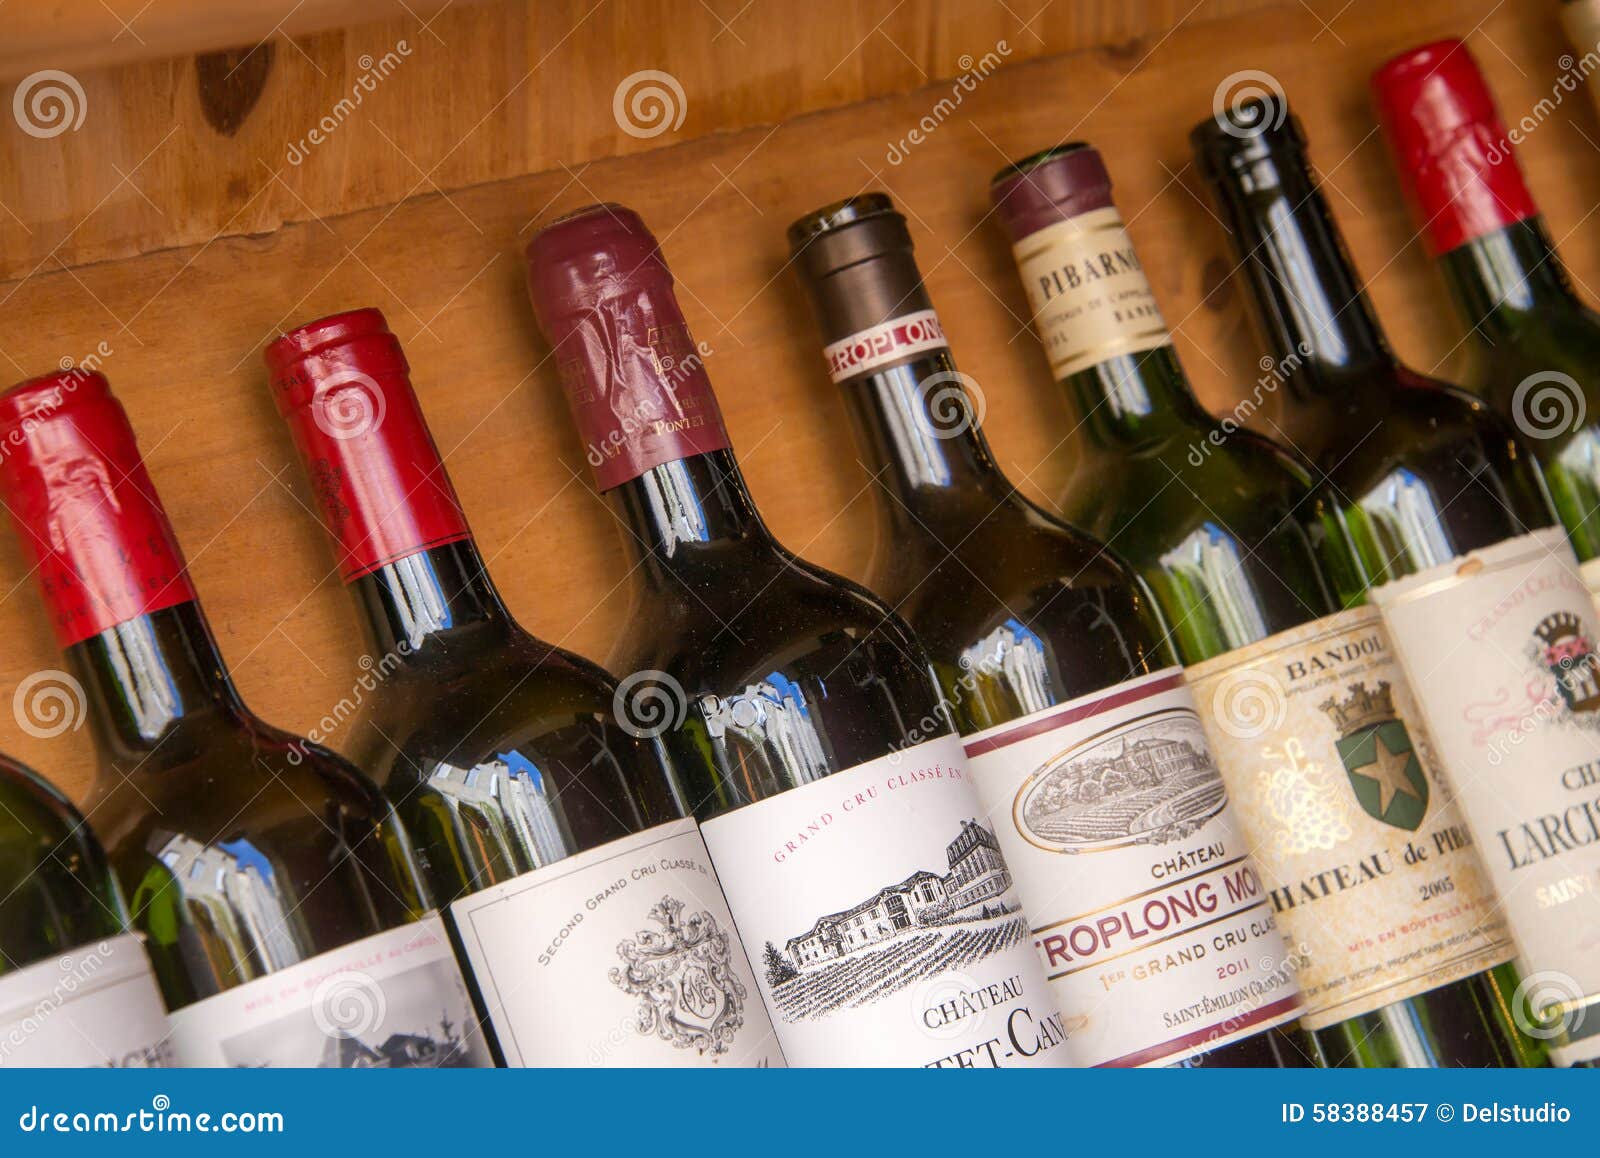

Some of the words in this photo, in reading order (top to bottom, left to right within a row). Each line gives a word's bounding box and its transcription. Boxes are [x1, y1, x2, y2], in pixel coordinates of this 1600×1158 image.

[1285, 635, 1385, 682] BANDOL
[774, 811, 834, 864] GRAND
[842, 785, 879, 813] CRU
[887, 763, 943, 791] CLASSÉ
[1150, 840, 1226, 879] CHÂTEAU
[1267, 848, 1396, 914] HATEAU
[1404, 842, 1429, 866] de
[537, 912, 585, 967] SECOND
[585, 878, 629, 912] GRAND
[631, 862, 657, 882] CRU
[1034, 882, 1219, 968] ROPLONG
[1223, 863, 1264, 905] MO
[1132, 943, 1207, 982] GRAND
[1213, 927, 1248, 952] CRU
[1216, 957, 1250, 980] 2011
[923, 974, 1025, 1029] CHÂTEAU
